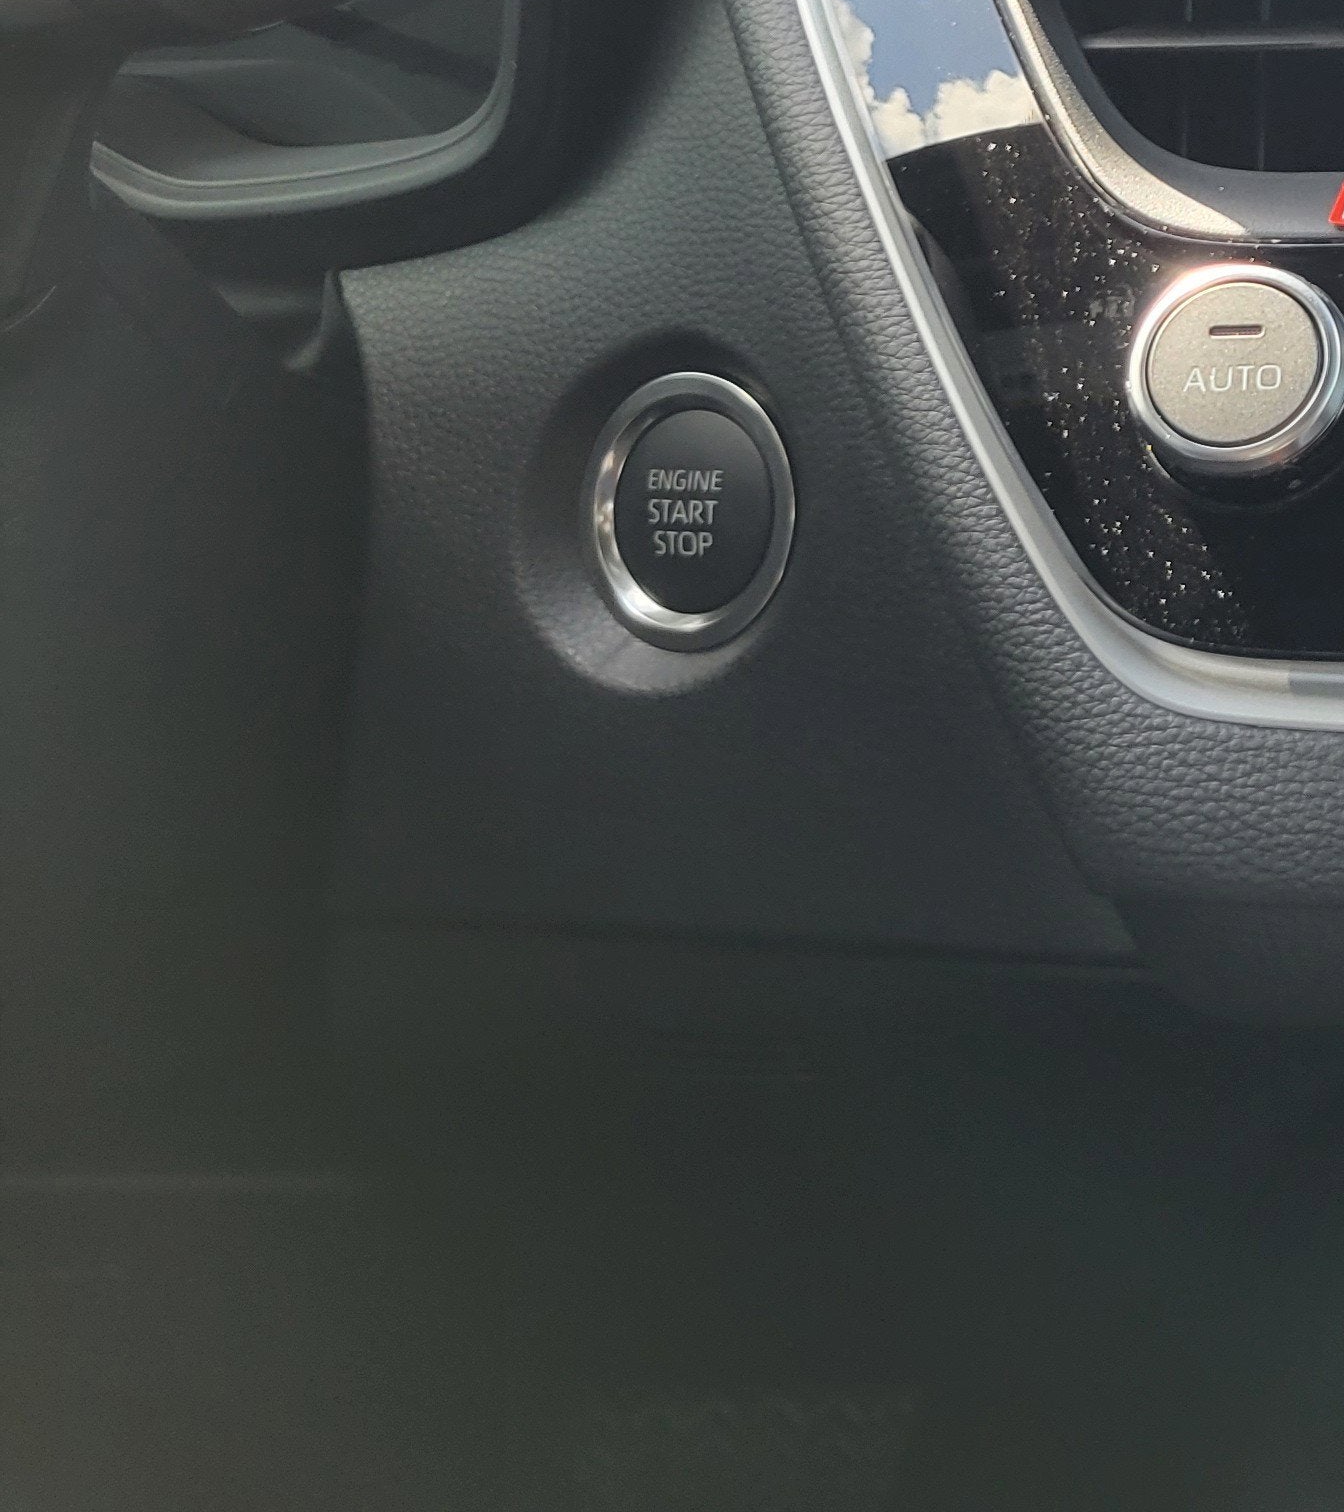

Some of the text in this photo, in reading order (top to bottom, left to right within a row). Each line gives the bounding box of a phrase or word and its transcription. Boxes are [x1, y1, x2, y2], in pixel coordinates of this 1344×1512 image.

[1182, 364, 1283, 393] AUTO
[648, 468, 723, 491] ENGINE
[648, 499, 720, 525] START
[654, 531, 714, 557] STOP
